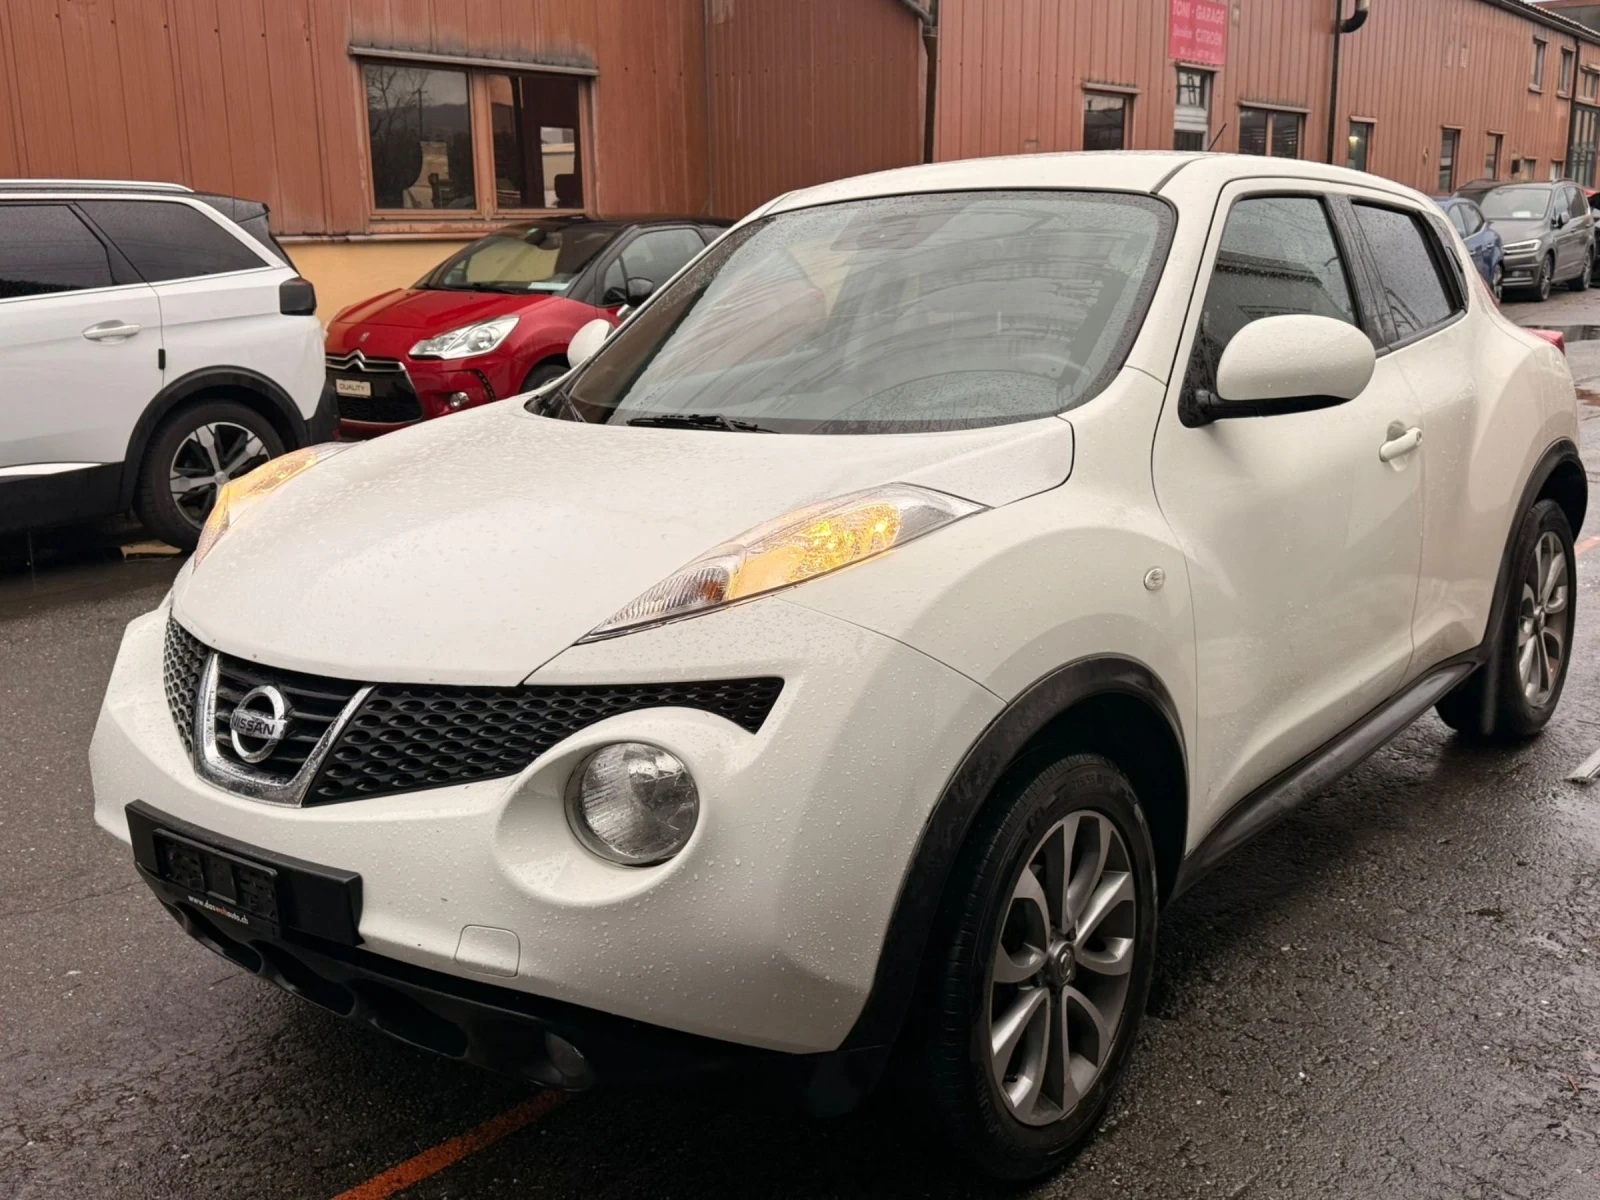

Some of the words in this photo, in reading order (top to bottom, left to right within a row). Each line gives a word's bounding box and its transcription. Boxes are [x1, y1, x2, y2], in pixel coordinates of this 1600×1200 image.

[1196, 4, 1225, 25] GARAGE
[339, 383, 366, 392] QUALITY
[232, 711, 276, 736] NISSAN
